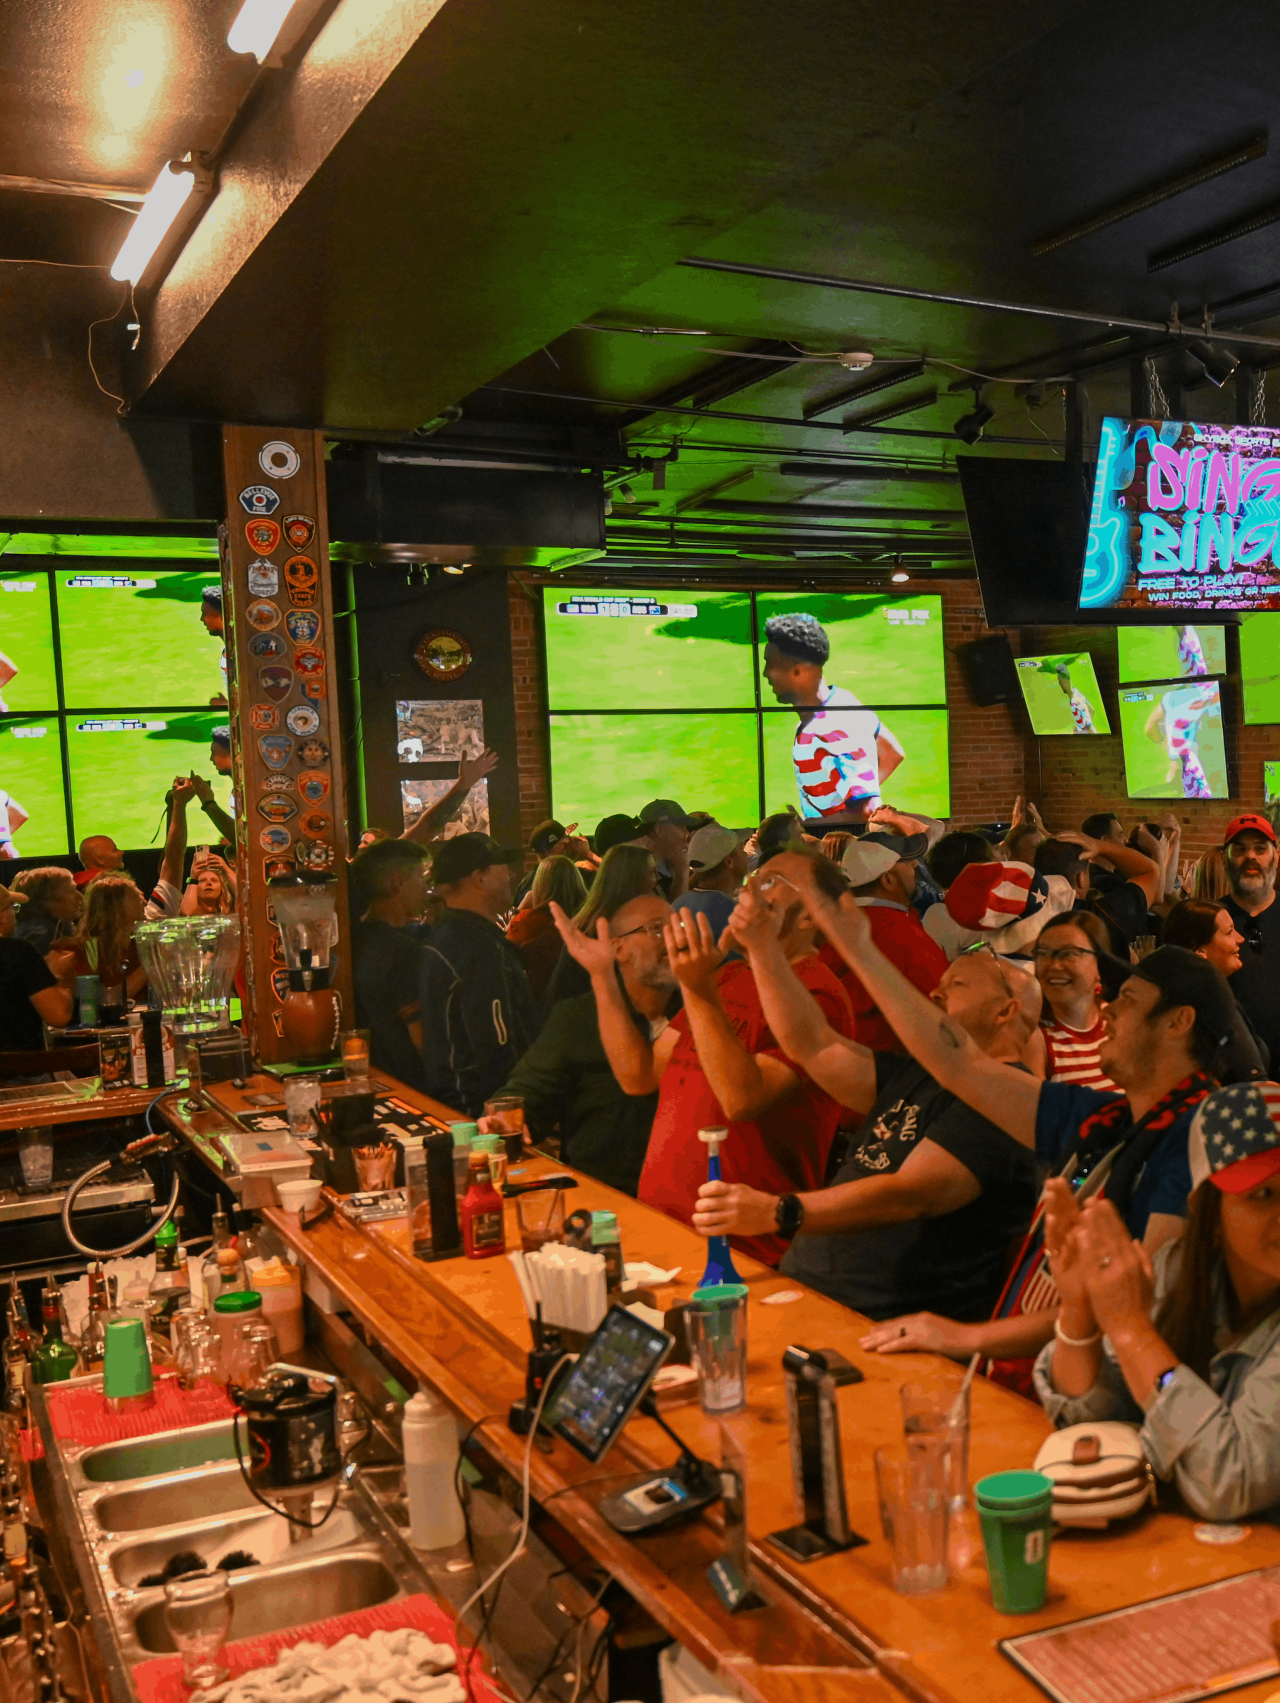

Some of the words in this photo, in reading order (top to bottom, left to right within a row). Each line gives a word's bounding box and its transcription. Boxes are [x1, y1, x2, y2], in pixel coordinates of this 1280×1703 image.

[243, 488, 276, 500] BELLEVUE
[1138, 578, 1175, 590] FREE
[1180, 576, 1200, 588] TO
[1203, 573, 1243, 586] PLAY!
[1148, 592, 1169, 601] WIN
[1172, 590, 1201, 600] FOOD,
[1205, 588, 1242, 598] DRINKS
[1245, 587, 1259, 595] OR
